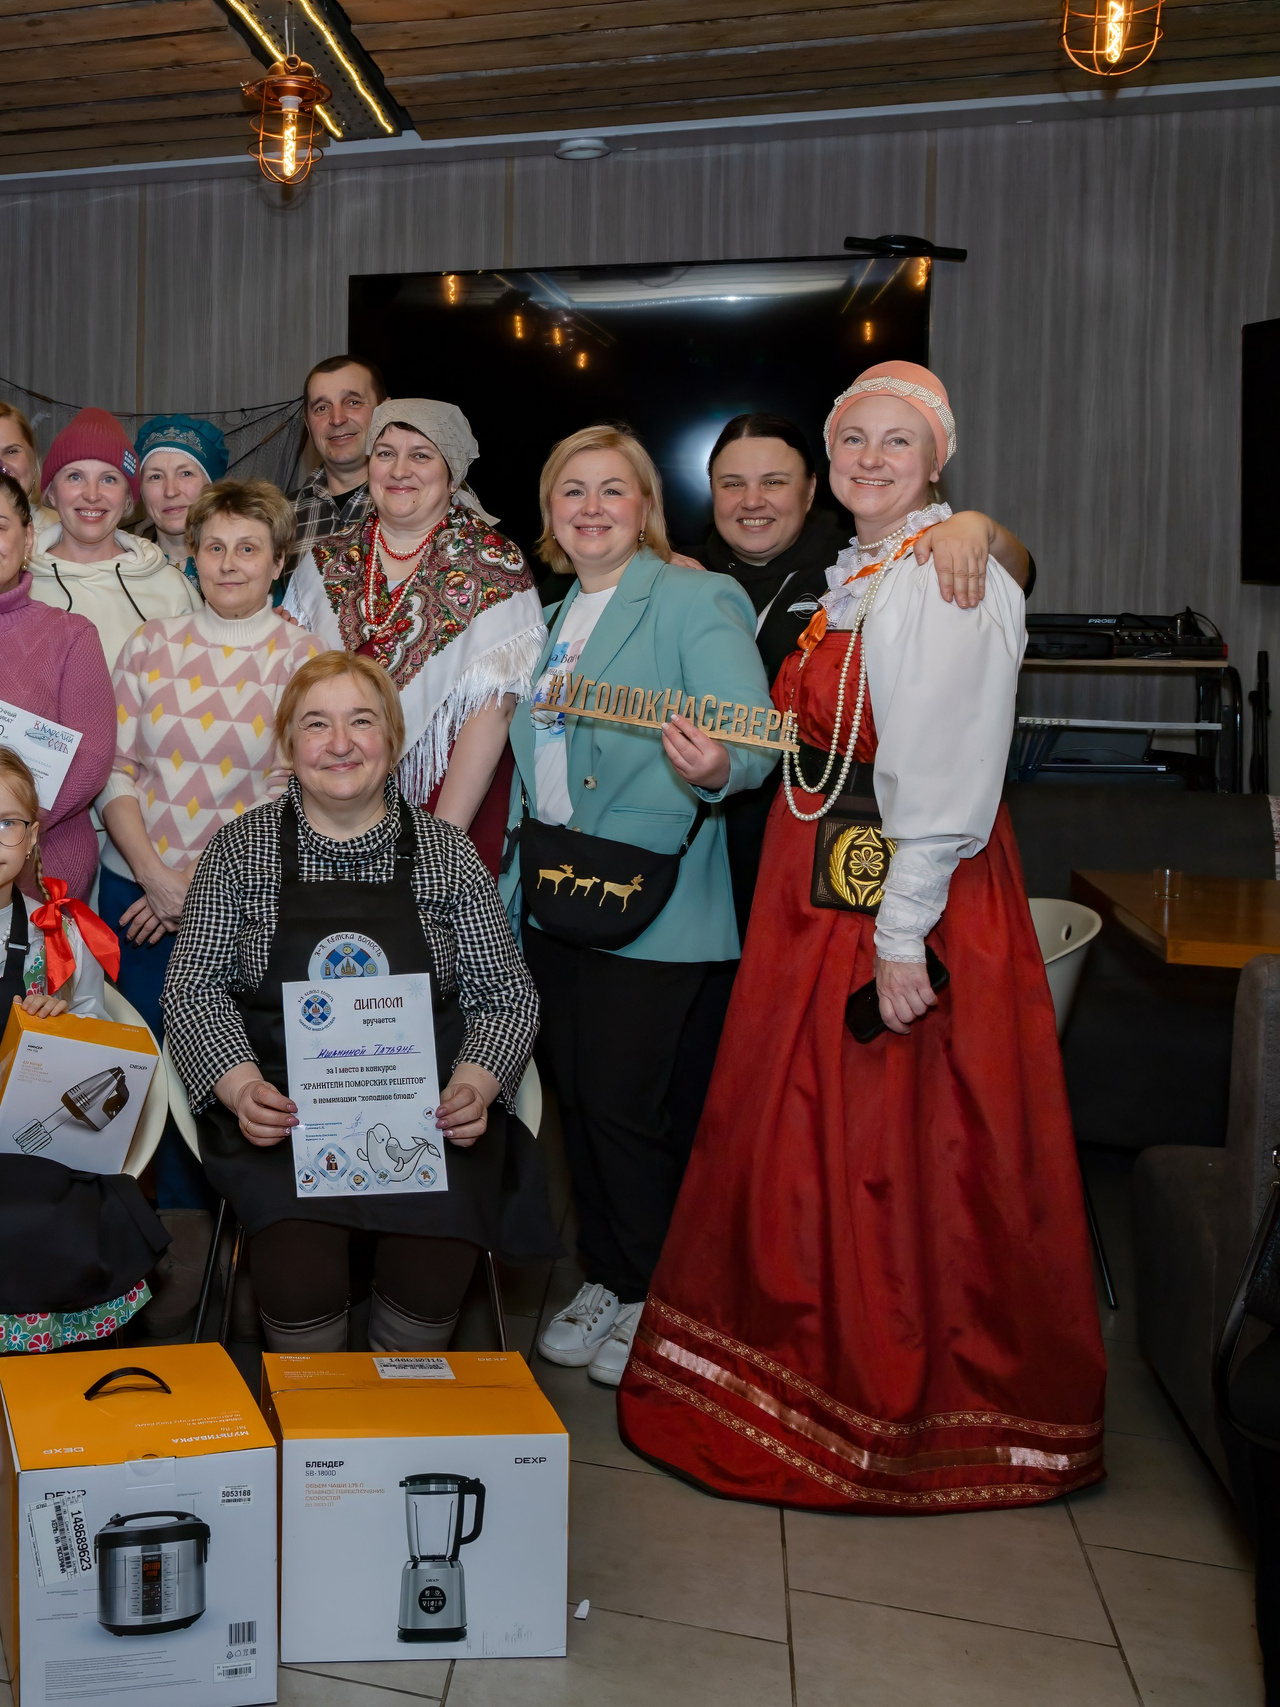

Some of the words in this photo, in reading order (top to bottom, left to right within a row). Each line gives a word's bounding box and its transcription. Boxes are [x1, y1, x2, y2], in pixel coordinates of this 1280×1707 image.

[353, 996, 404, 1011] ДИПЛОМ
[362, 1017, 396, 1026] вручается
[129, 1063, 148, 1071] DEXP
[365, 1064, 397, 1074] конкурсе
[345, 1079, 388, 1088] ПОМОРСКИХ
[318, 1096, 357, 1104] номинации
[171, 1430, 249, 1444] МУЛЬТИВАРКА
[43, 1446, 84, 1455] DEXP
[514, 1456, 547, 1465] DEXP
[70, 1510, 92, 1572] 148689623
